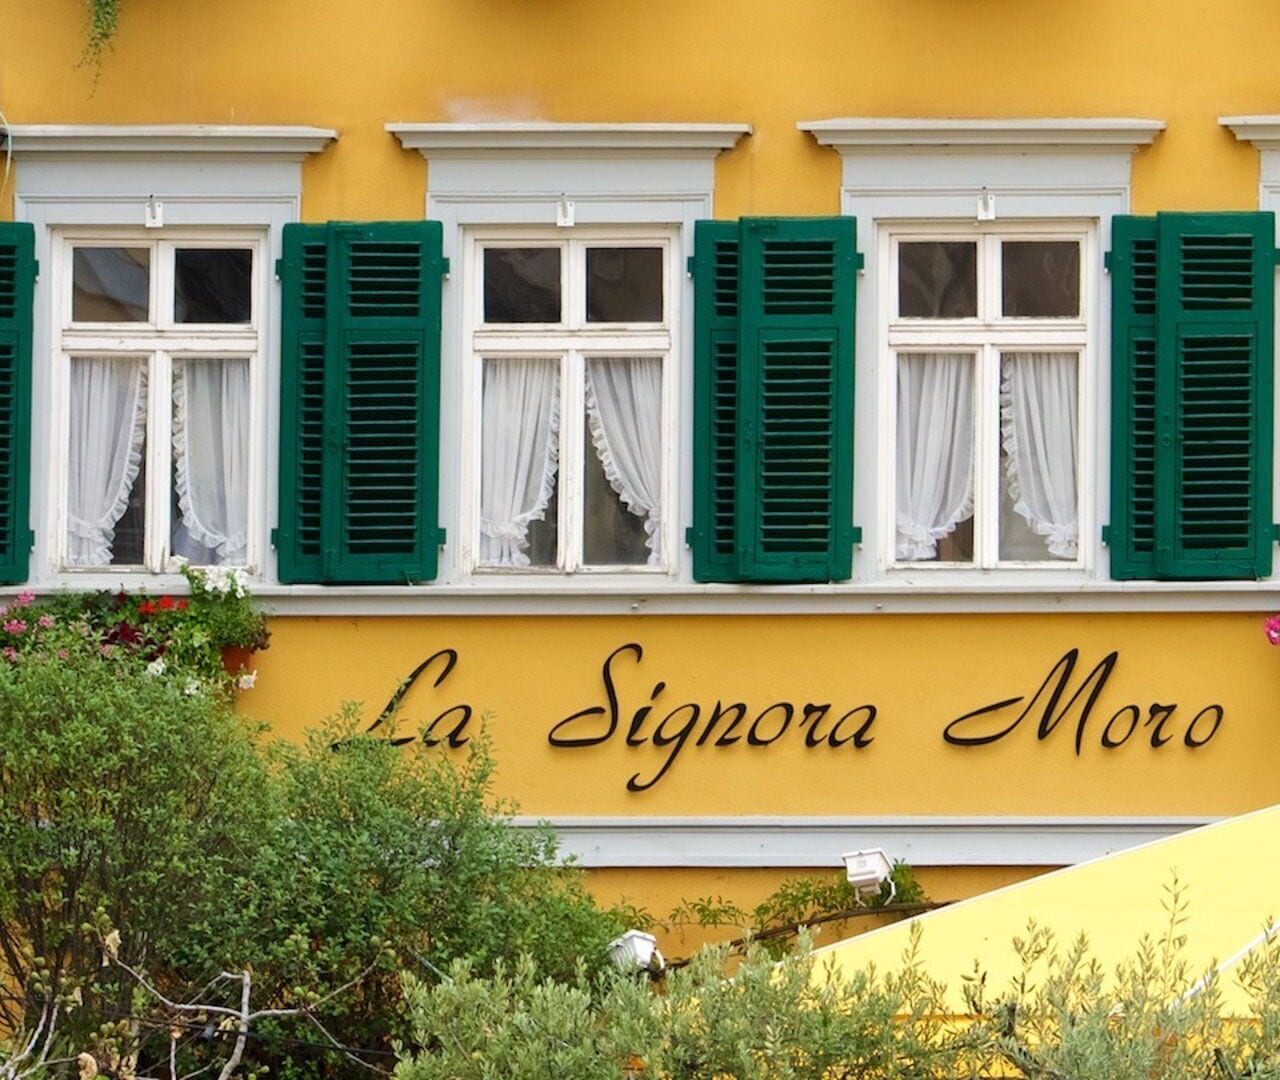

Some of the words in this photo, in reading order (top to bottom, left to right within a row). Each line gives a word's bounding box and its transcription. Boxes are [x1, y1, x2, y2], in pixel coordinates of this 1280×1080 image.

[329, 648, 472, 754] La
[547, 642, 877, 792] Signora
[942, 647, 1225, 756] Moro
